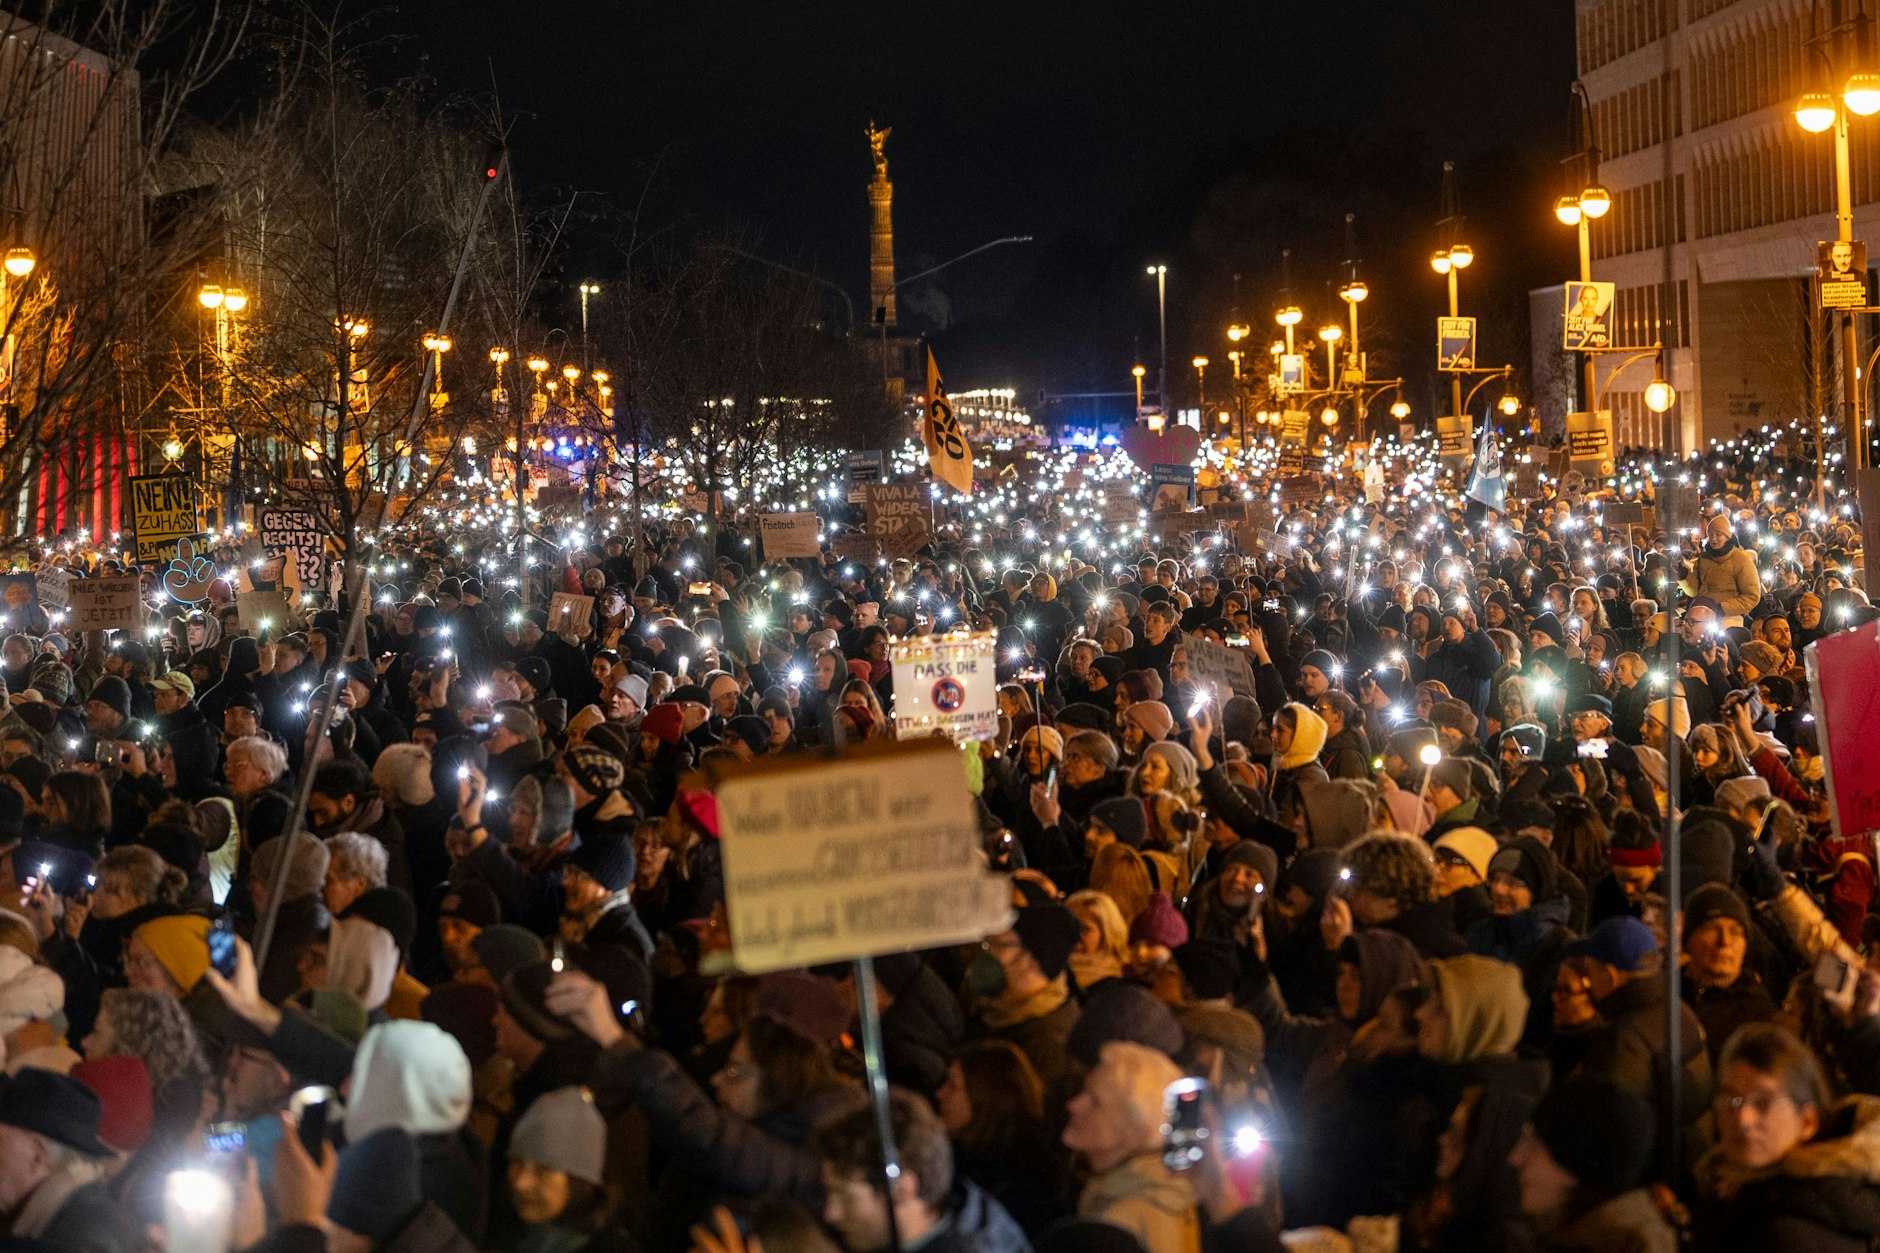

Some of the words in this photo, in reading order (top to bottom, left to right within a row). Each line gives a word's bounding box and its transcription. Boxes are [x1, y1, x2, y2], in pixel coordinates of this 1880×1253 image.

[1590, 334, 1607, 343] AfD
[1587, 438, 1608, 446] wieder
[136, 476, 192, 514] NEIN!
[872, 487, 901, 500] VIVA
[902, 486, 921, 499] LA
[263, 512, 316, 530] GEGEN
[263, 531, 322, 554] RECHTS!
[72, 582, 96, 595] NIE
[94, 594, 114, 605] IST
[914, 661, 953, 679] DASS
[956, 660, 978, 674] DIE
